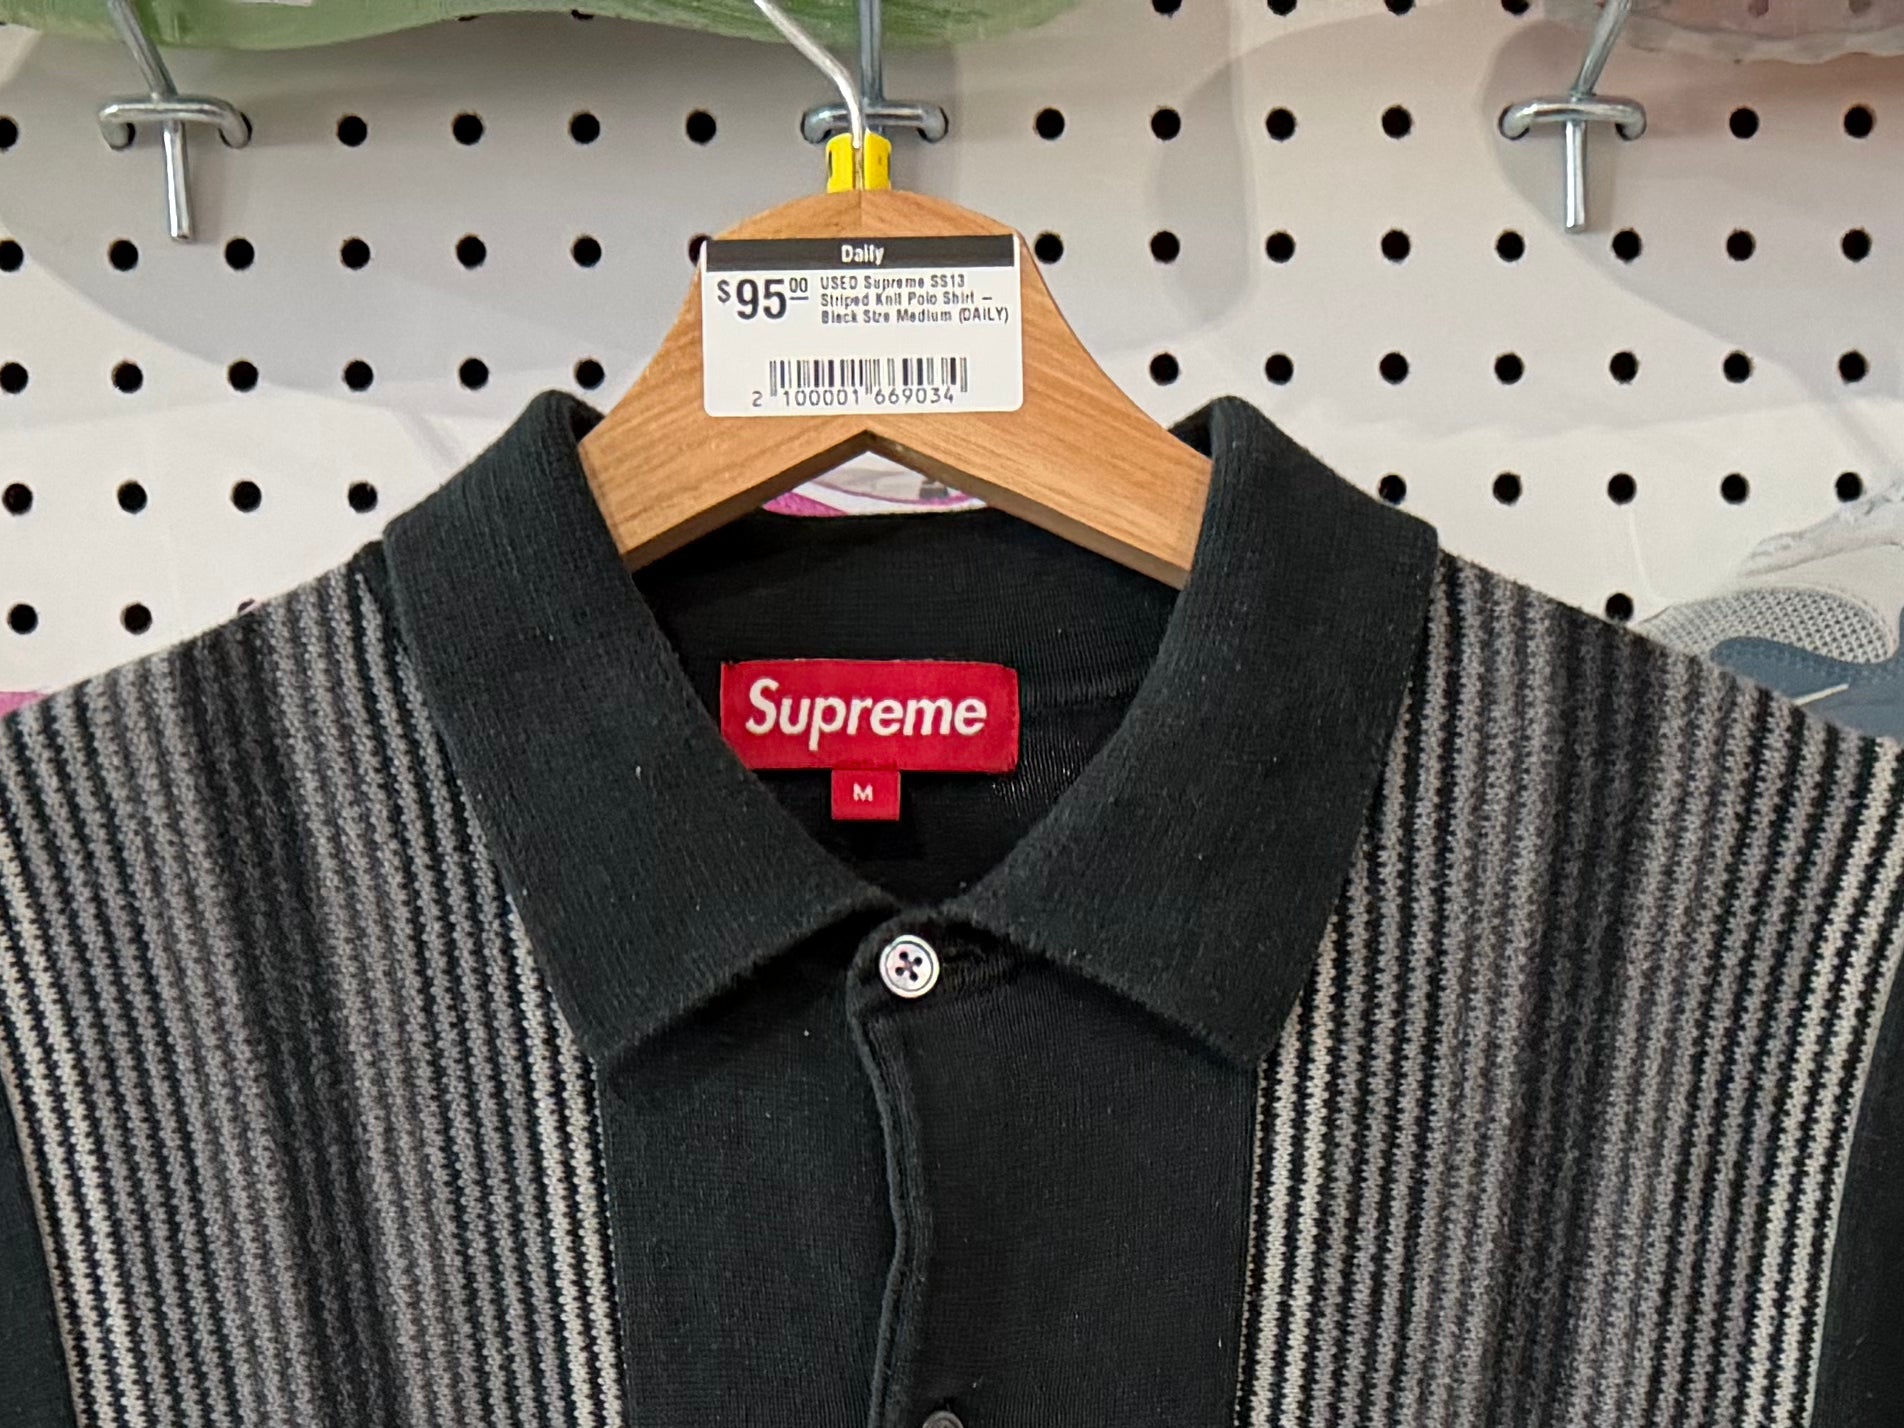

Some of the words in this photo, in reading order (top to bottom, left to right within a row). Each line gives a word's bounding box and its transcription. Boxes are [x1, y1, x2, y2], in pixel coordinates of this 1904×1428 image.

[841, 244, 884, 265] Daily
[820, 276, 858, 290] USED
[864, 275, 925, 292] Supreme
[930, 274, 965, 288] SS13
[821, 293, 870, 309] Striped
[875, 293, 902, 306] Knit
[908, 293, 938, 306] Polo
[943, 291, 975, 305] Shirt
[821, 310, 858, 324] Black
[863, 309, 890, 323] Size
[896, 308, 952, 323] Medium
[958, 307, 1009, 324] (DAILY)
[746, 677, 987, 751] Supreme
[853, 782, 873, 801] M
